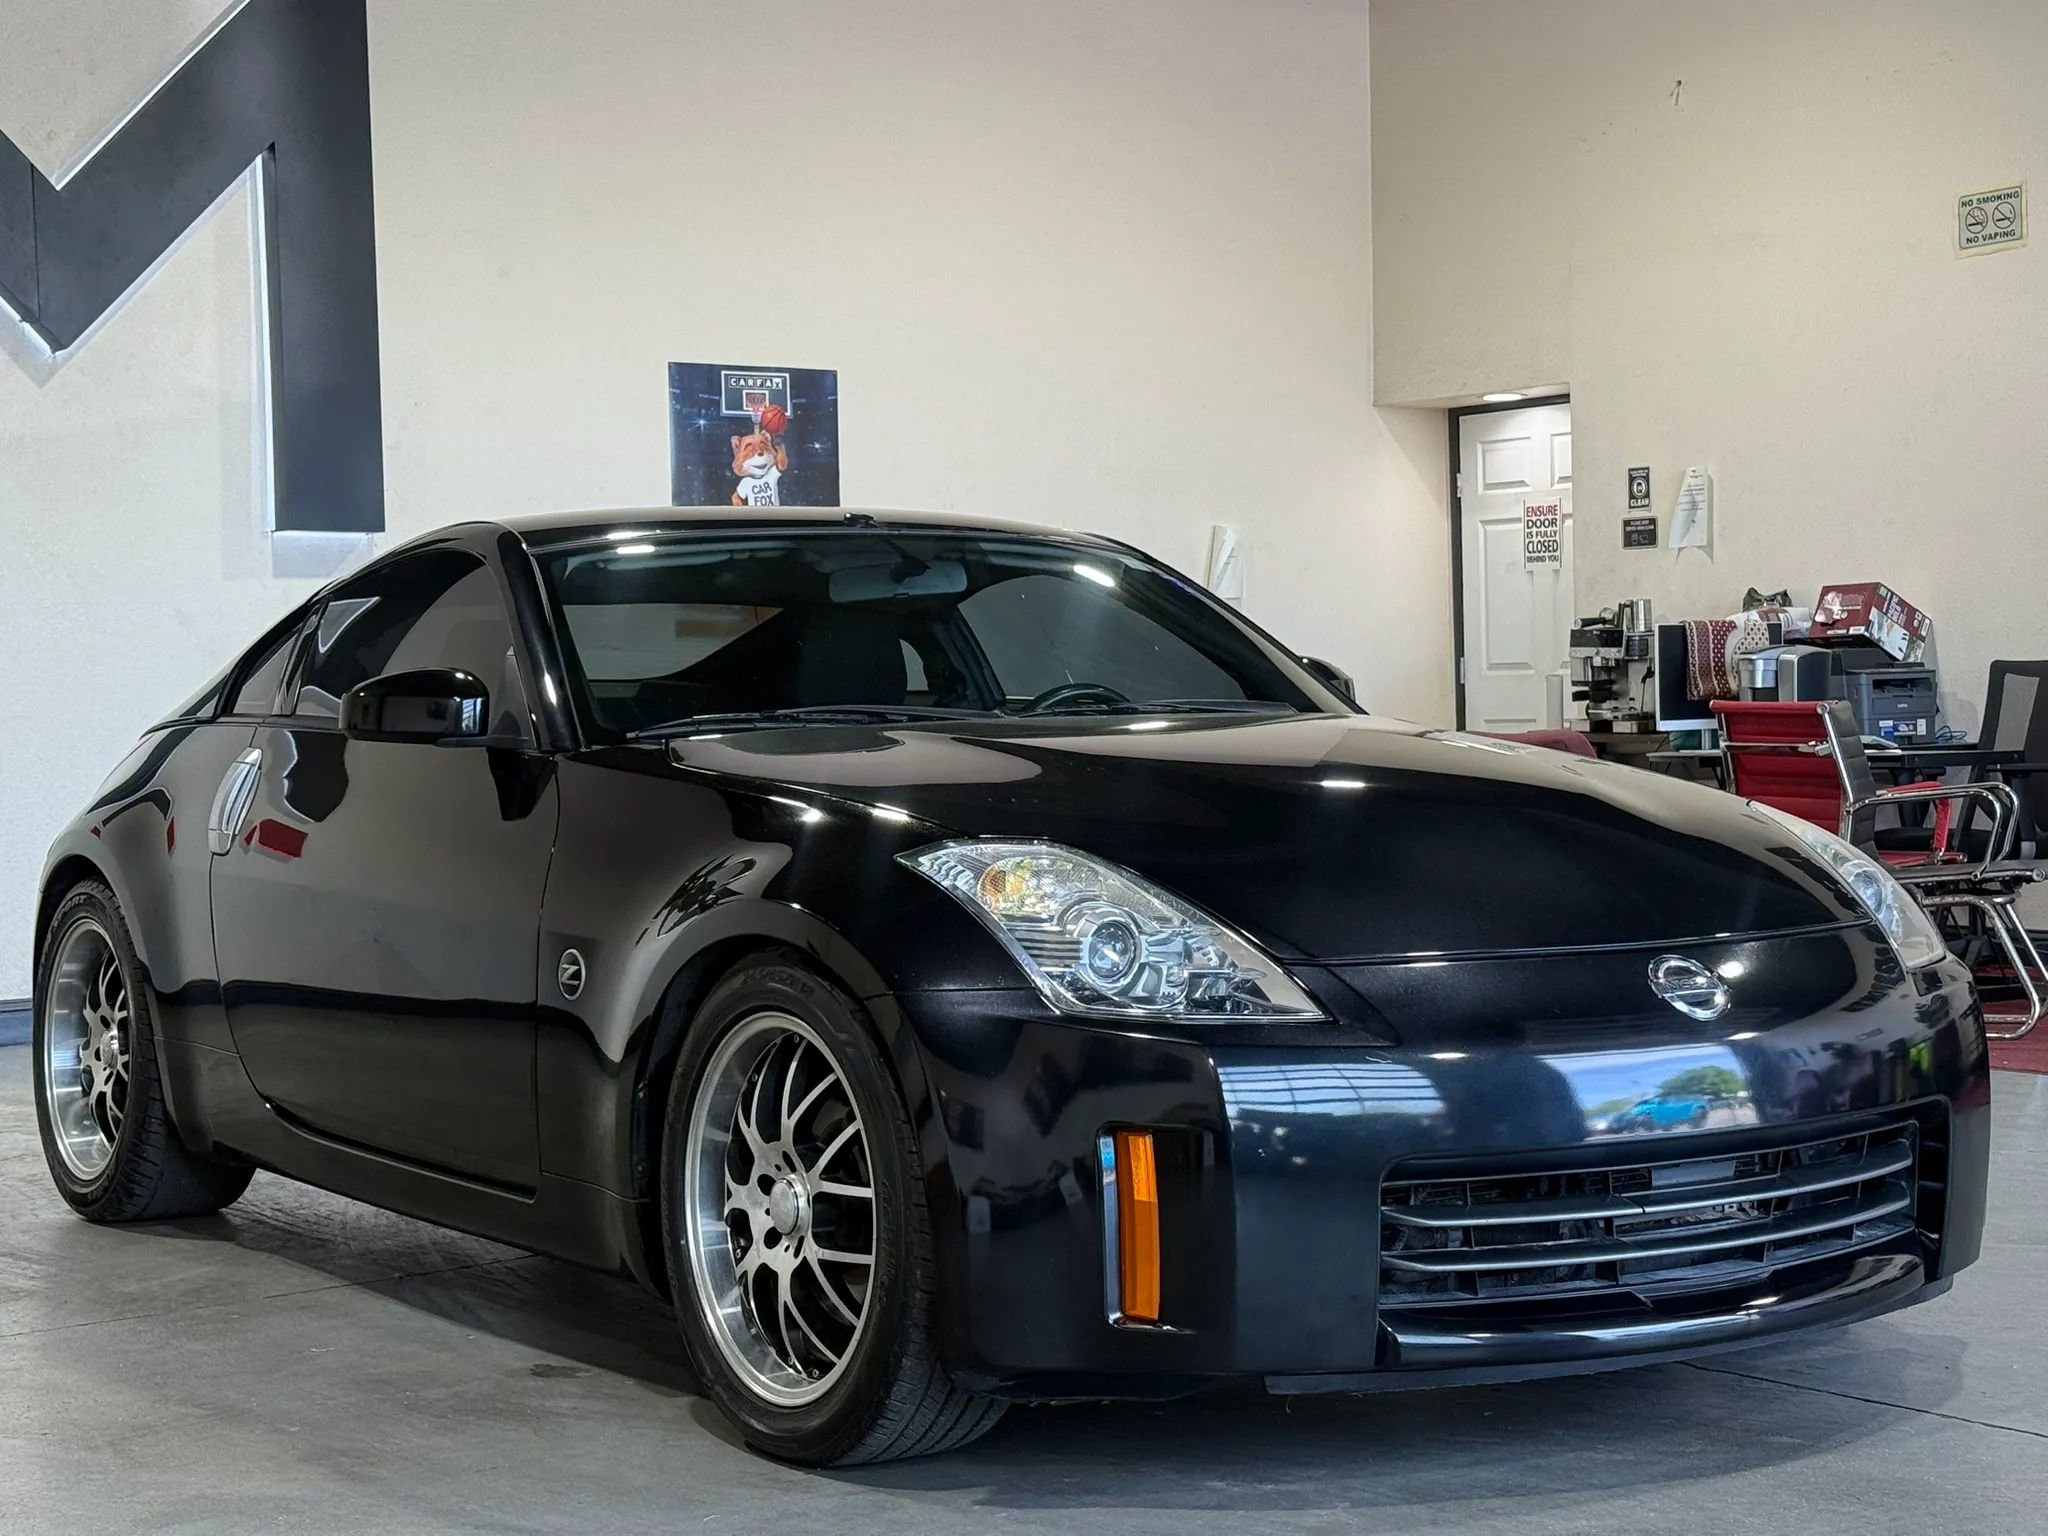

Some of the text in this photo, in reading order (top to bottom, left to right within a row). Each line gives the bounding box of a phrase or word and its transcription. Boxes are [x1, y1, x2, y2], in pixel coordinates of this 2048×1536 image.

[1961, 191, 2020, 208] NO SMOKING
[1966, 229, 2016, 245] NO VAPING
[730, 377, 783, 389] CARFAX
[752, 481, 773, 495] CAR
[754, 493, 774, 506] FOX
[1526, 504, 1558, 518] ENSURE
[1526, 517, 1558, 529] DOOR
[1526, 529, 1558, 540] IS FULLY
[1526, 539, 1559, 554] CLOSED
[1526, 554, 1559, 563] BEHIND YOU
[561, 963, 580, 986] Z
